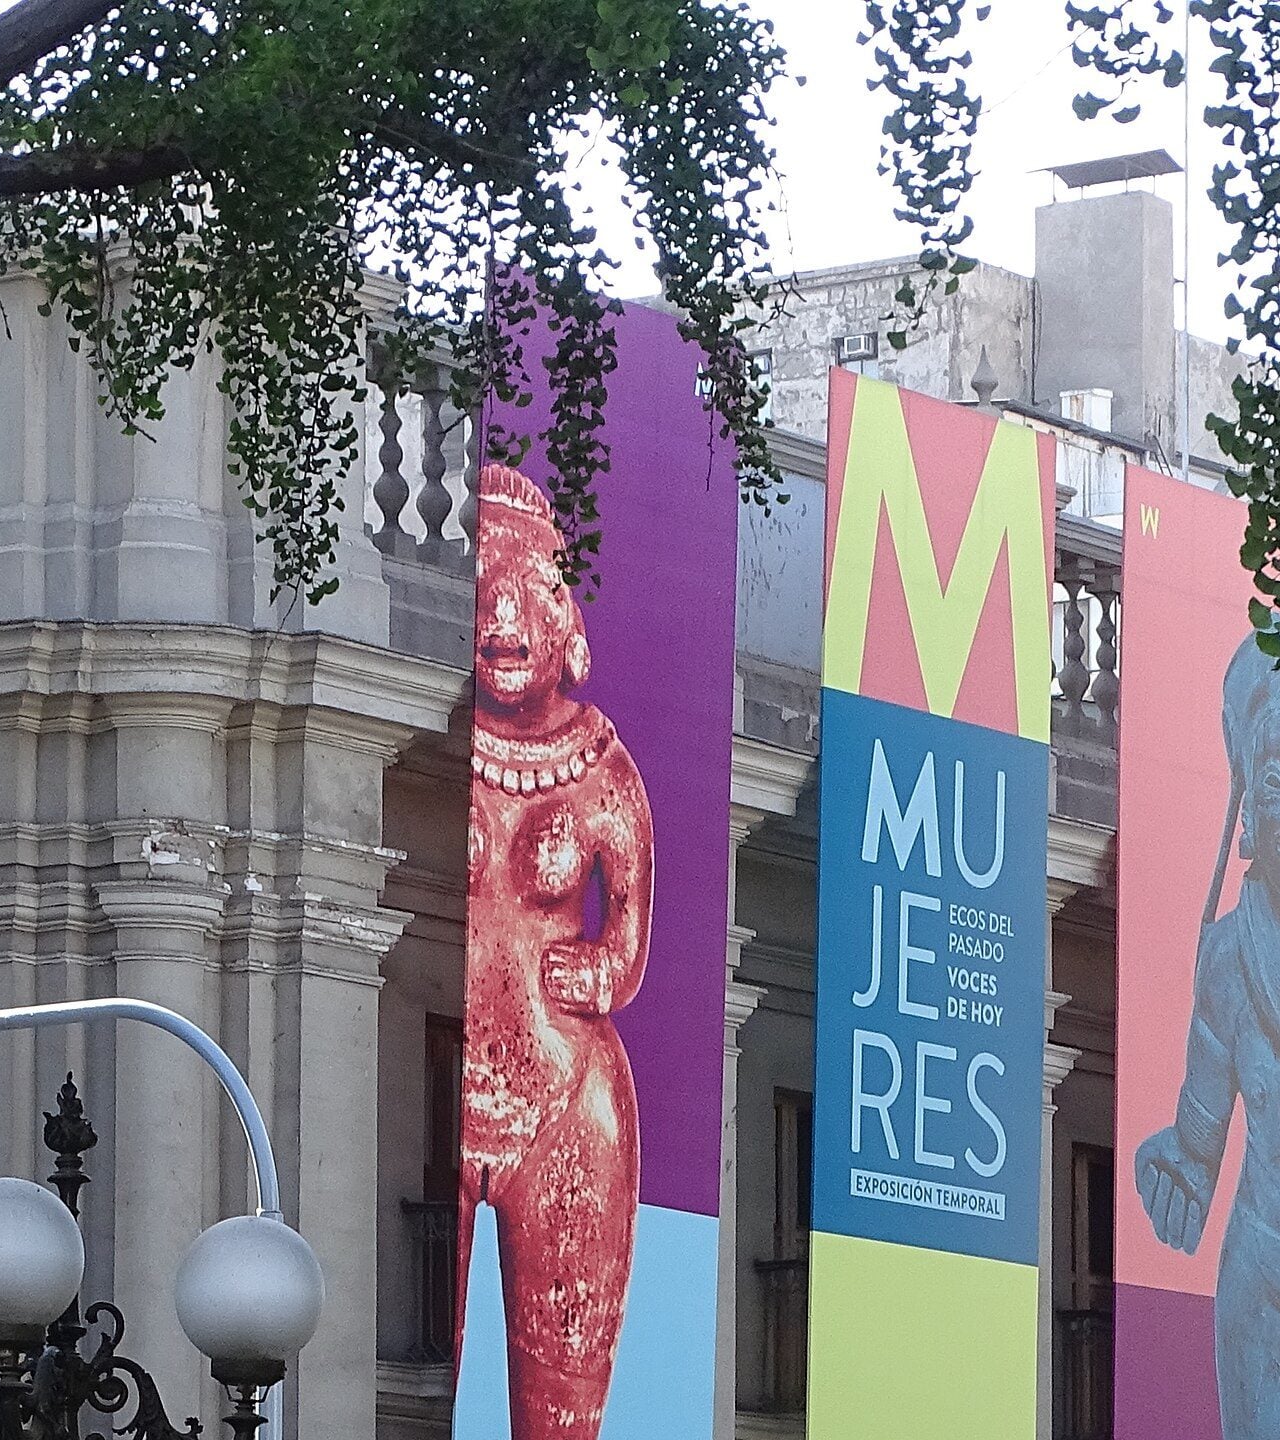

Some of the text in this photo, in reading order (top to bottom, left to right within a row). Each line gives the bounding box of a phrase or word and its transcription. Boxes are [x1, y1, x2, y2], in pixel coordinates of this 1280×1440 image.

[860, 738, 1006, 889] MU
[949, 903, 1015, 937] ECOS DEL
[851, 884, 942, 1021] JE
[948, 932, 1004, 963] PASADO
[947, 965, 997, 996] VOCES
[947, 996, 1003, 1027] DE HOY
[851, 1028, 1006, 1179] RES
[856, 1174, 1000, 1215] EXPOSICIÓN TEMPORAL
